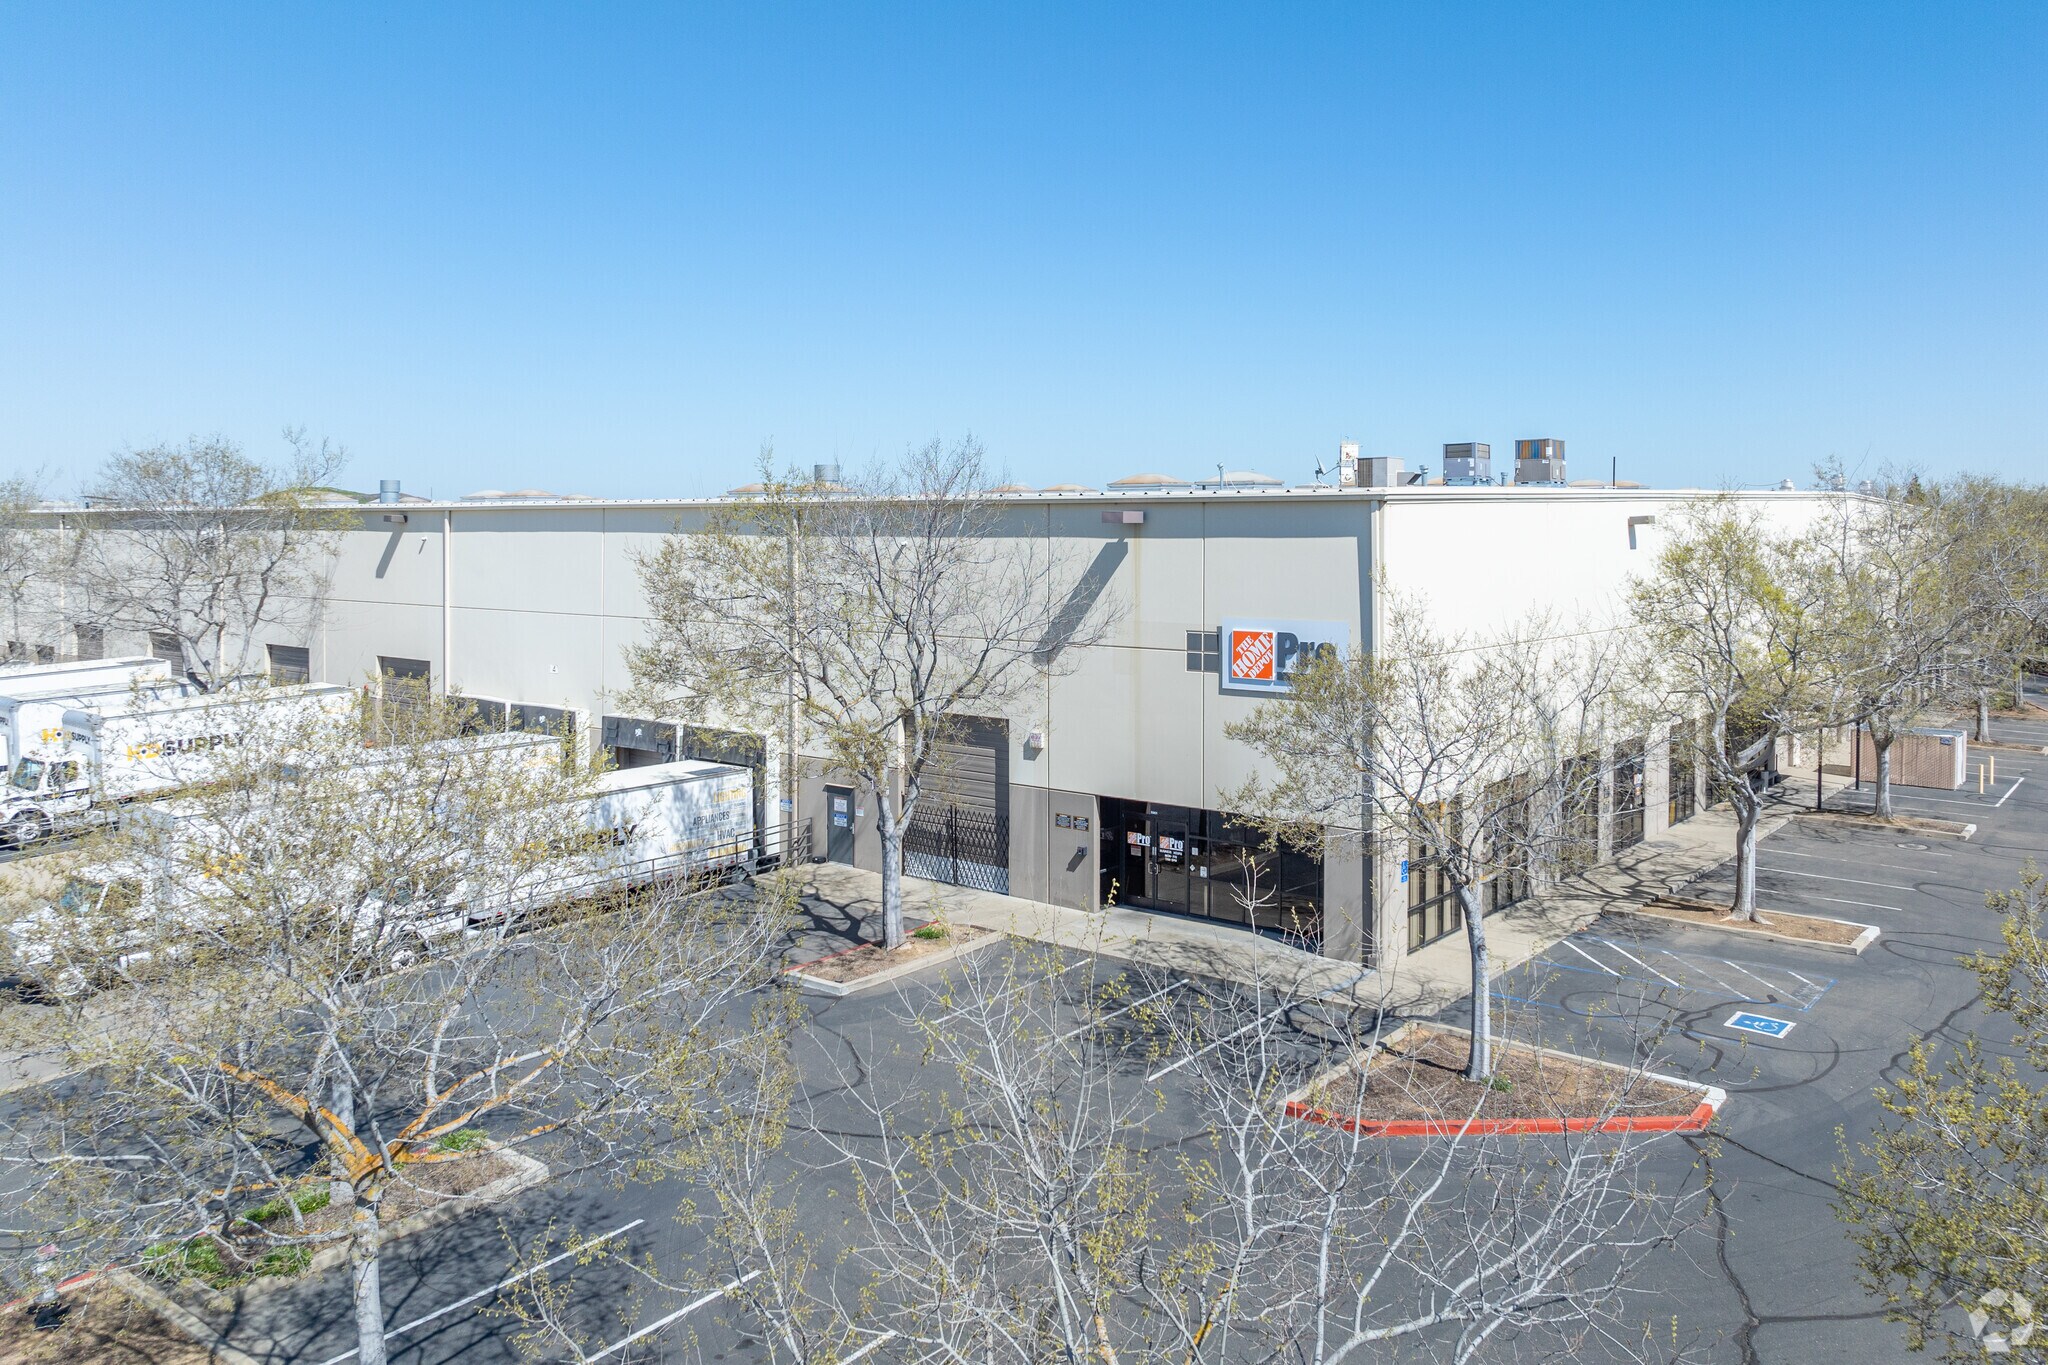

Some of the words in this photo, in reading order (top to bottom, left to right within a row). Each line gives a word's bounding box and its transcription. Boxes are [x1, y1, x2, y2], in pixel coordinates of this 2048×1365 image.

[1236, 635, 1254, 654] THE
[1232, 632, 1272, 678] HOME
[1248, 649, 1273, 678] DEPOT
[71, 731, 91, 744] SUPPLY
[693, 810, 730, 827] APPLIANCES
[717, 827, 736, 840] HVAC
[1138, 832, 1151, 844] Pro
[1169, 837, 1183, 849] Pro
